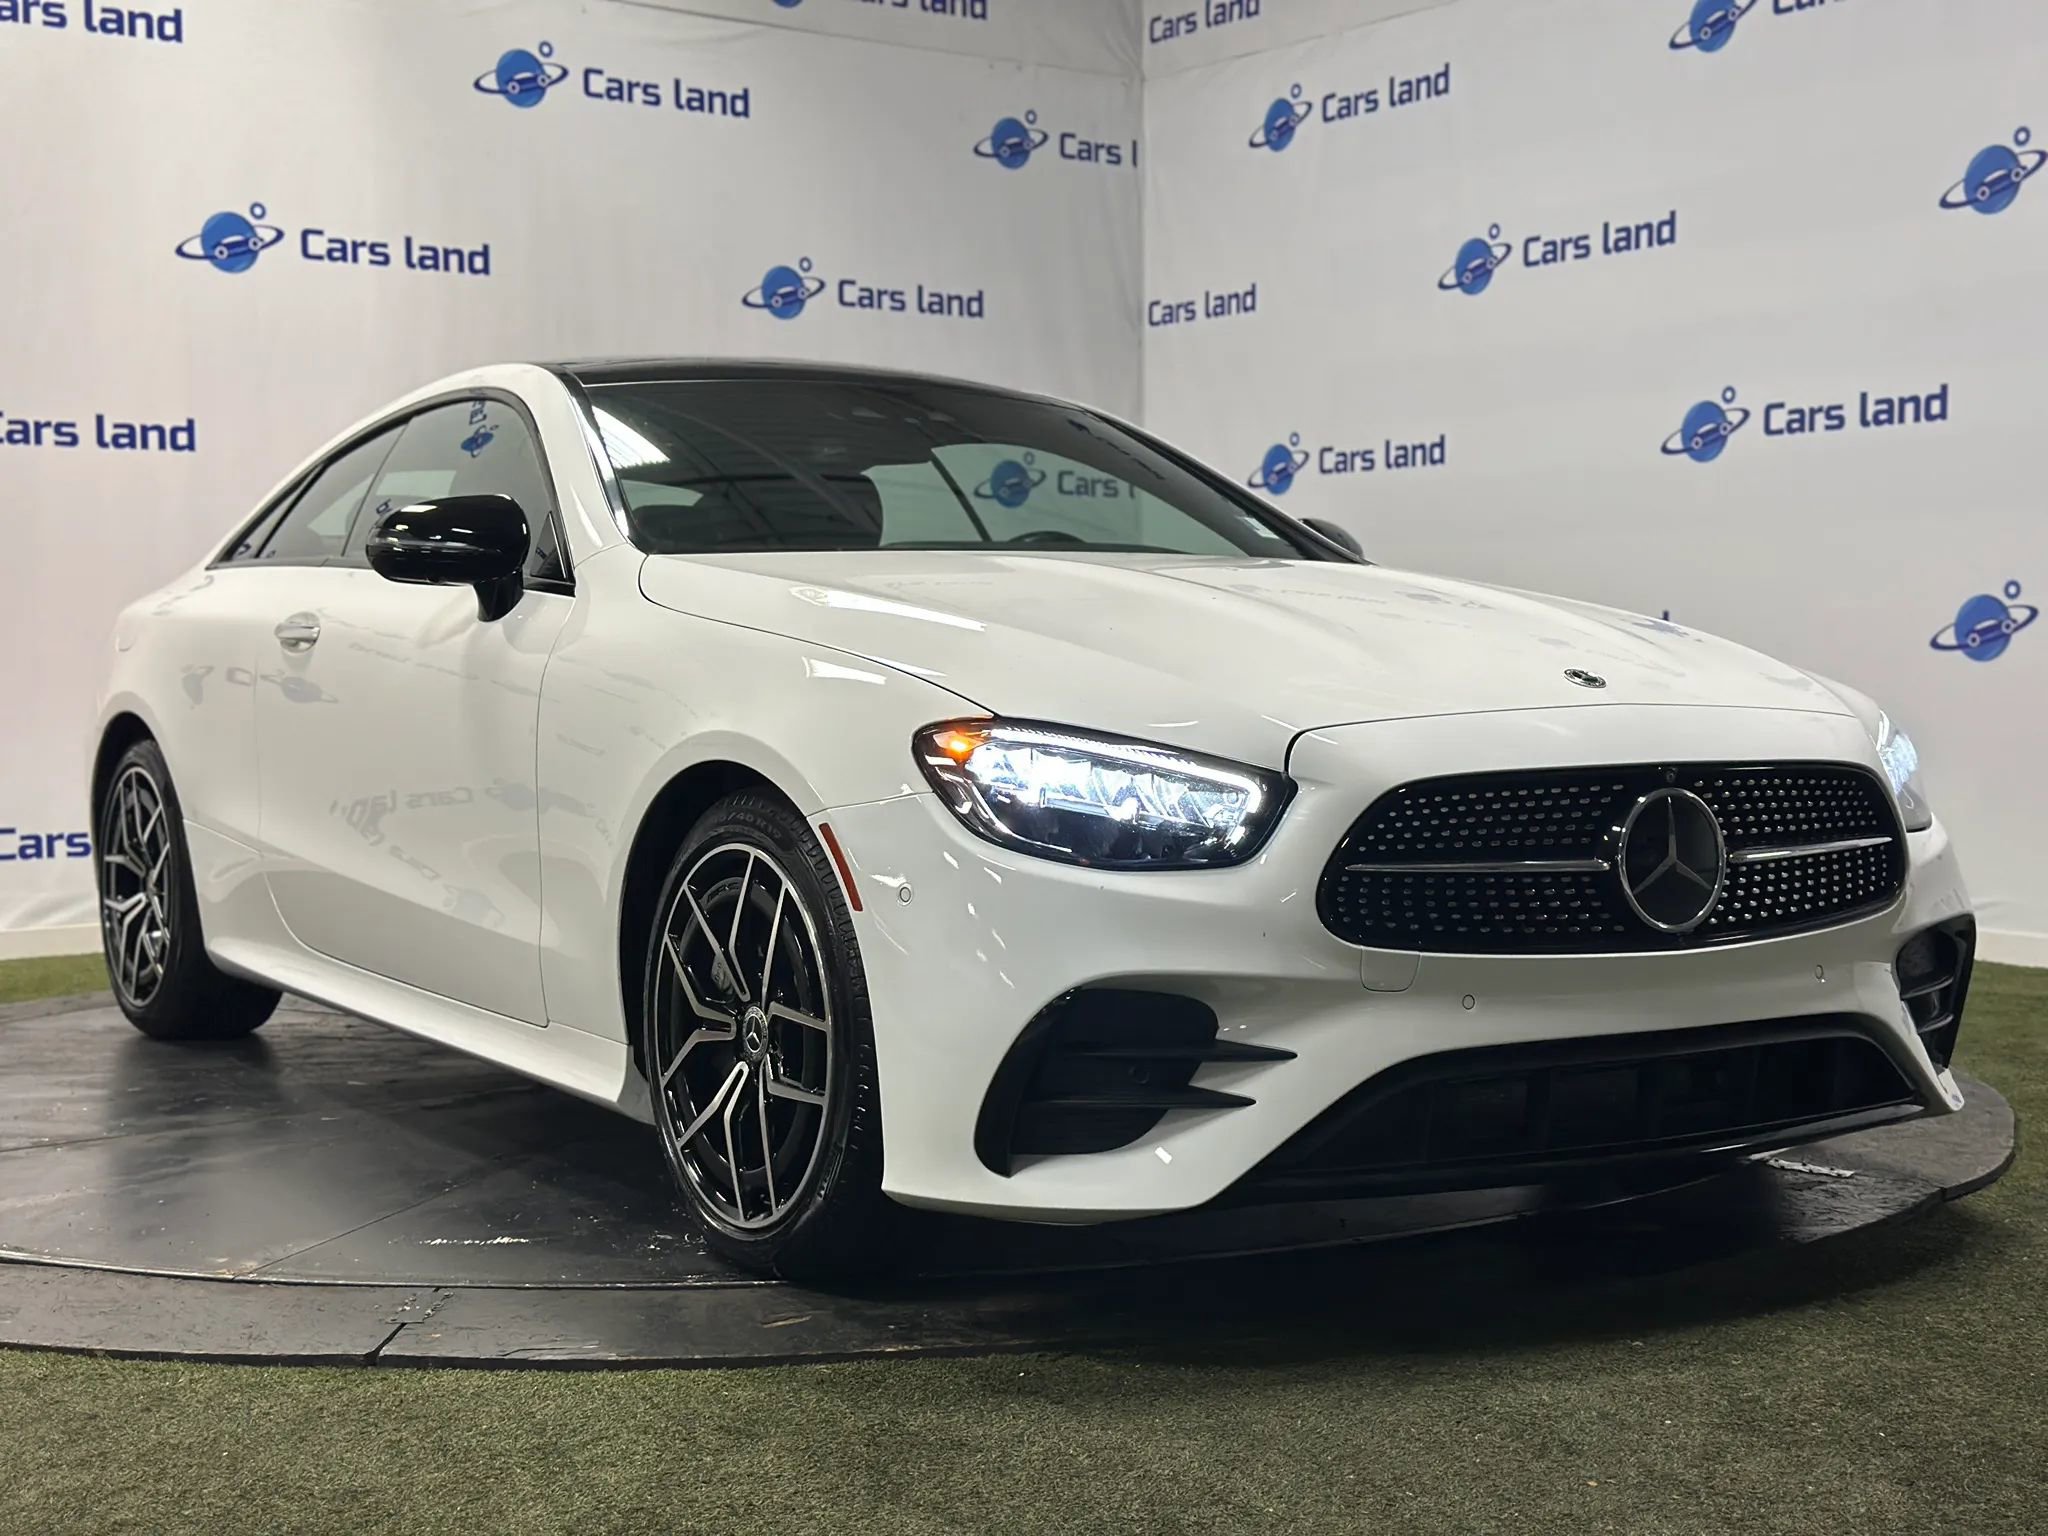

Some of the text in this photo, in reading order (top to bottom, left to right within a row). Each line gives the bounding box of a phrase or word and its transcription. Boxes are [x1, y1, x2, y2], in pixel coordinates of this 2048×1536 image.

[0, 0, 183, 44] ars land
[1149, 0, 1260, 45] Cars land
[583, 67, 750, 119] Cars land
[1321, 62, 1450, 124] Cars land
[1059, 131, 1122, 166] Cars
[300, 228, 491, 276] Cars land
[1522, 209, 1677, 268] Cars land
[837, 279, 984, 319] Cars land
[1147, 282, 1257, 328] Cars land
[0, 410, 196, 452] ars land
[1763, 383, 1949, 437] Cars land
[1318, 433, 1446, 475] Cars land
[1057, 469, 1119, 499] Cars
